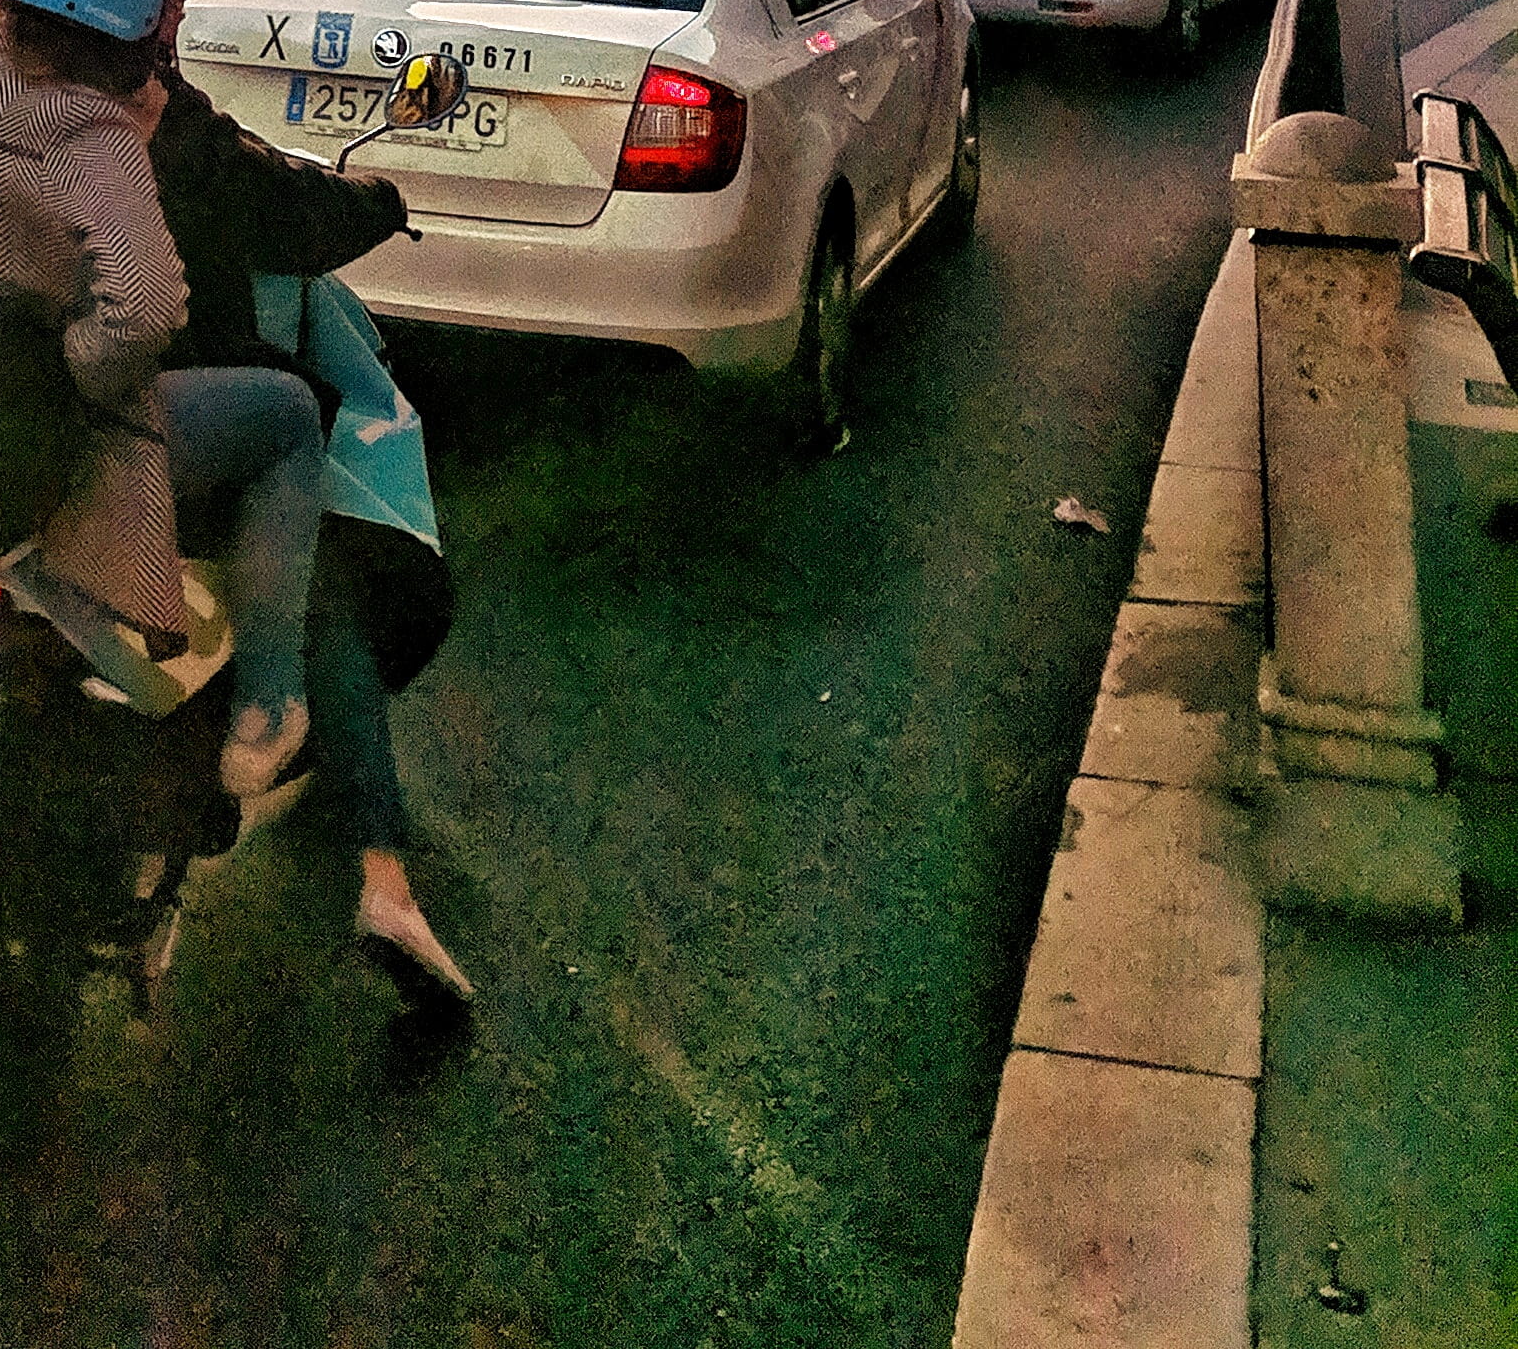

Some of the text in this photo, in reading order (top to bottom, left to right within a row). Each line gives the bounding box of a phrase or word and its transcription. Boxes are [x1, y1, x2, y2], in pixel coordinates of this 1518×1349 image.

[259, 14, 290, 61] X
[312, 84, 497, 139] 257 PG
